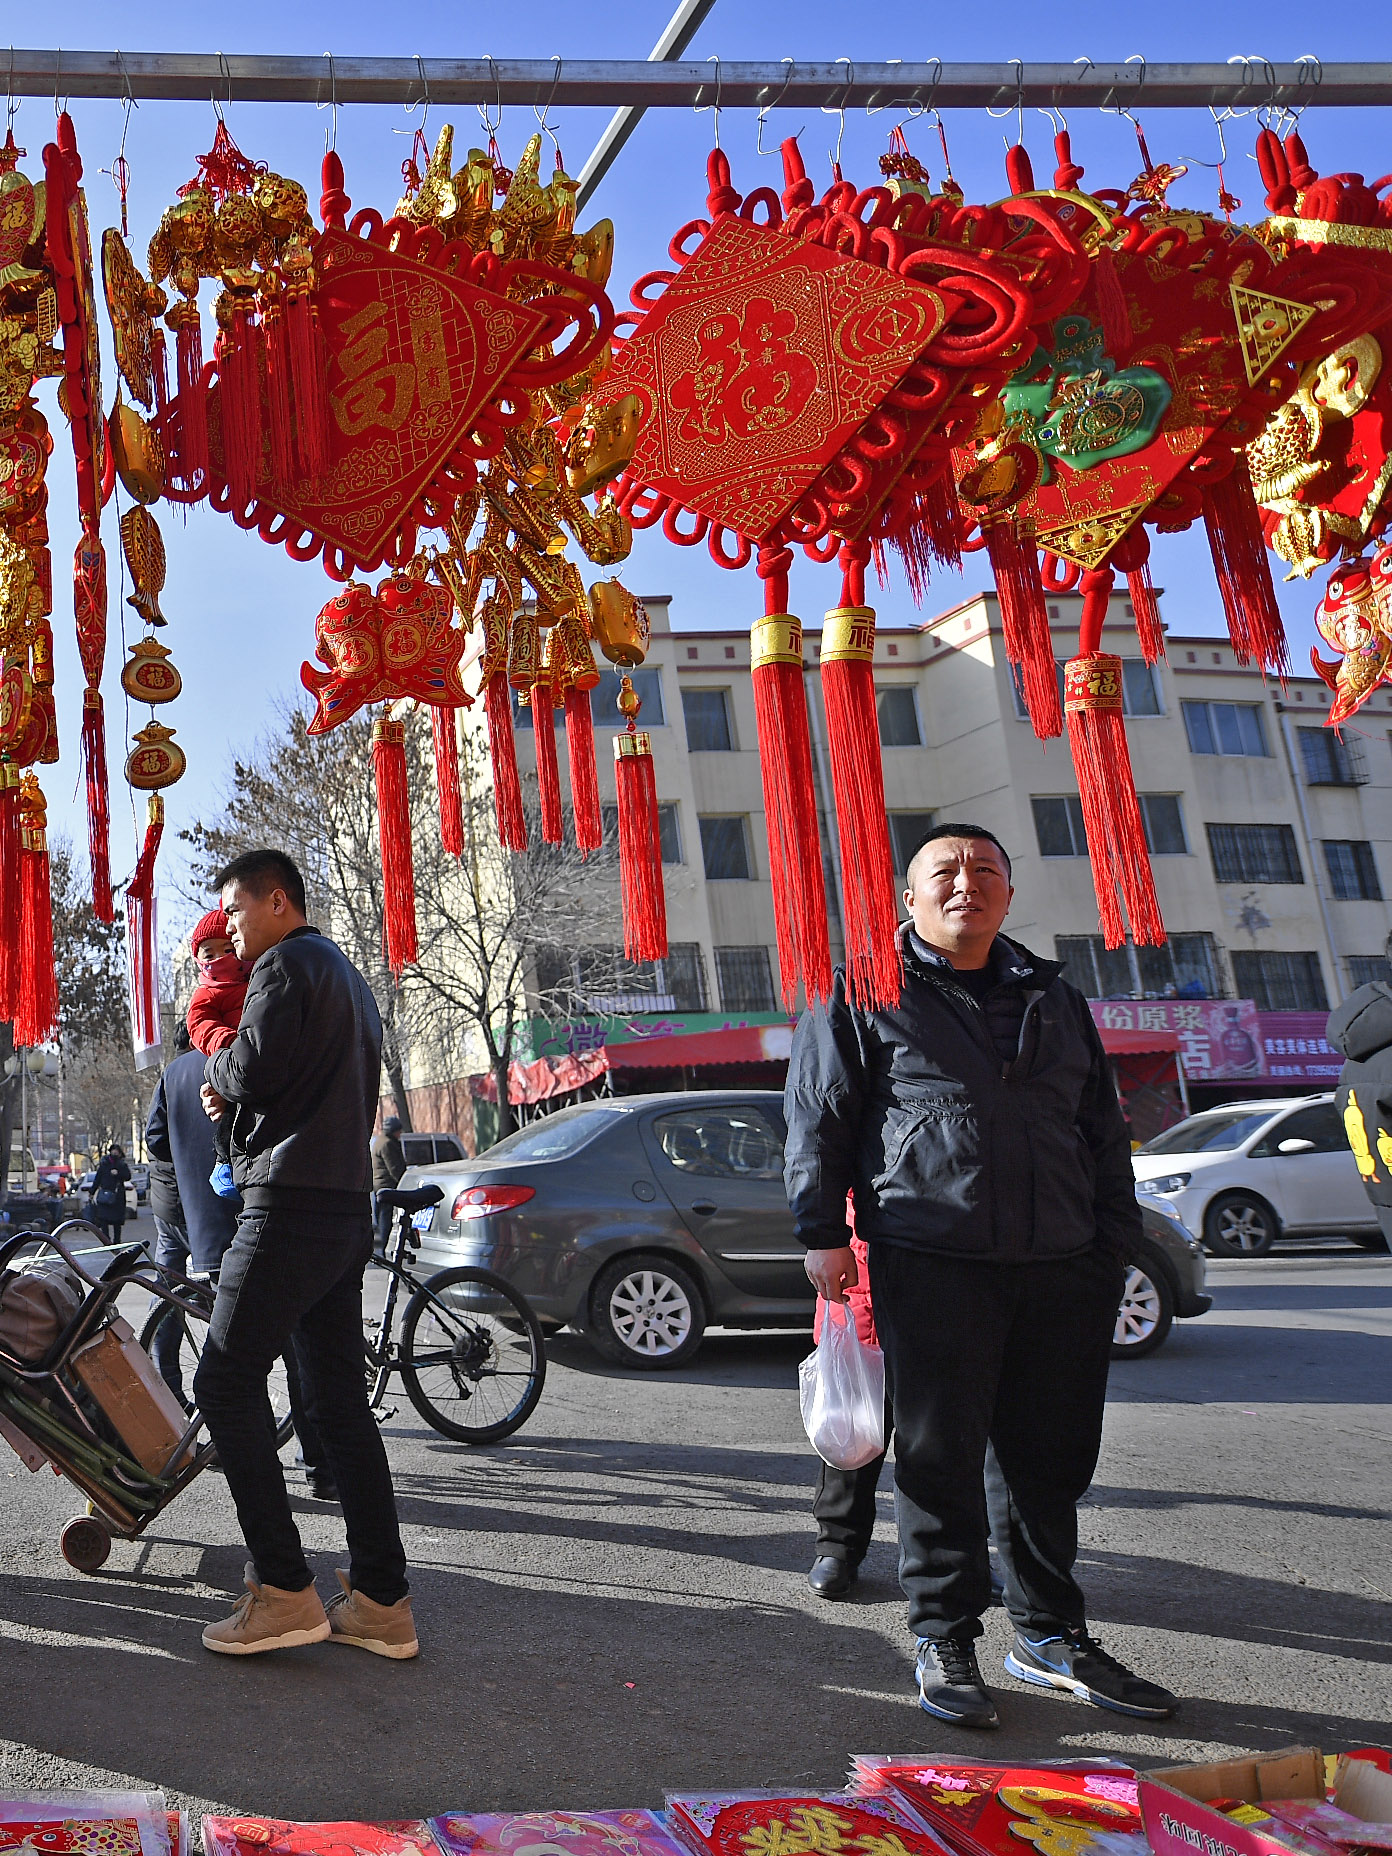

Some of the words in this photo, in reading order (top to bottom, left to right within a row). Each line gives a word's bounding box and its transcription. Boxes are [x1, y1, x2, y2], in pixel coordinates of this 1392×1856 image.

[1, 200, 28, 230] 福
[388, 625, 417, 657] 福
[146, 666, 166, 688] 福
[1087, 671, 1118, 696] 福
[141, 751, 161, 774] 福
[1090, 1005, 1205, 1030] 份原浆
